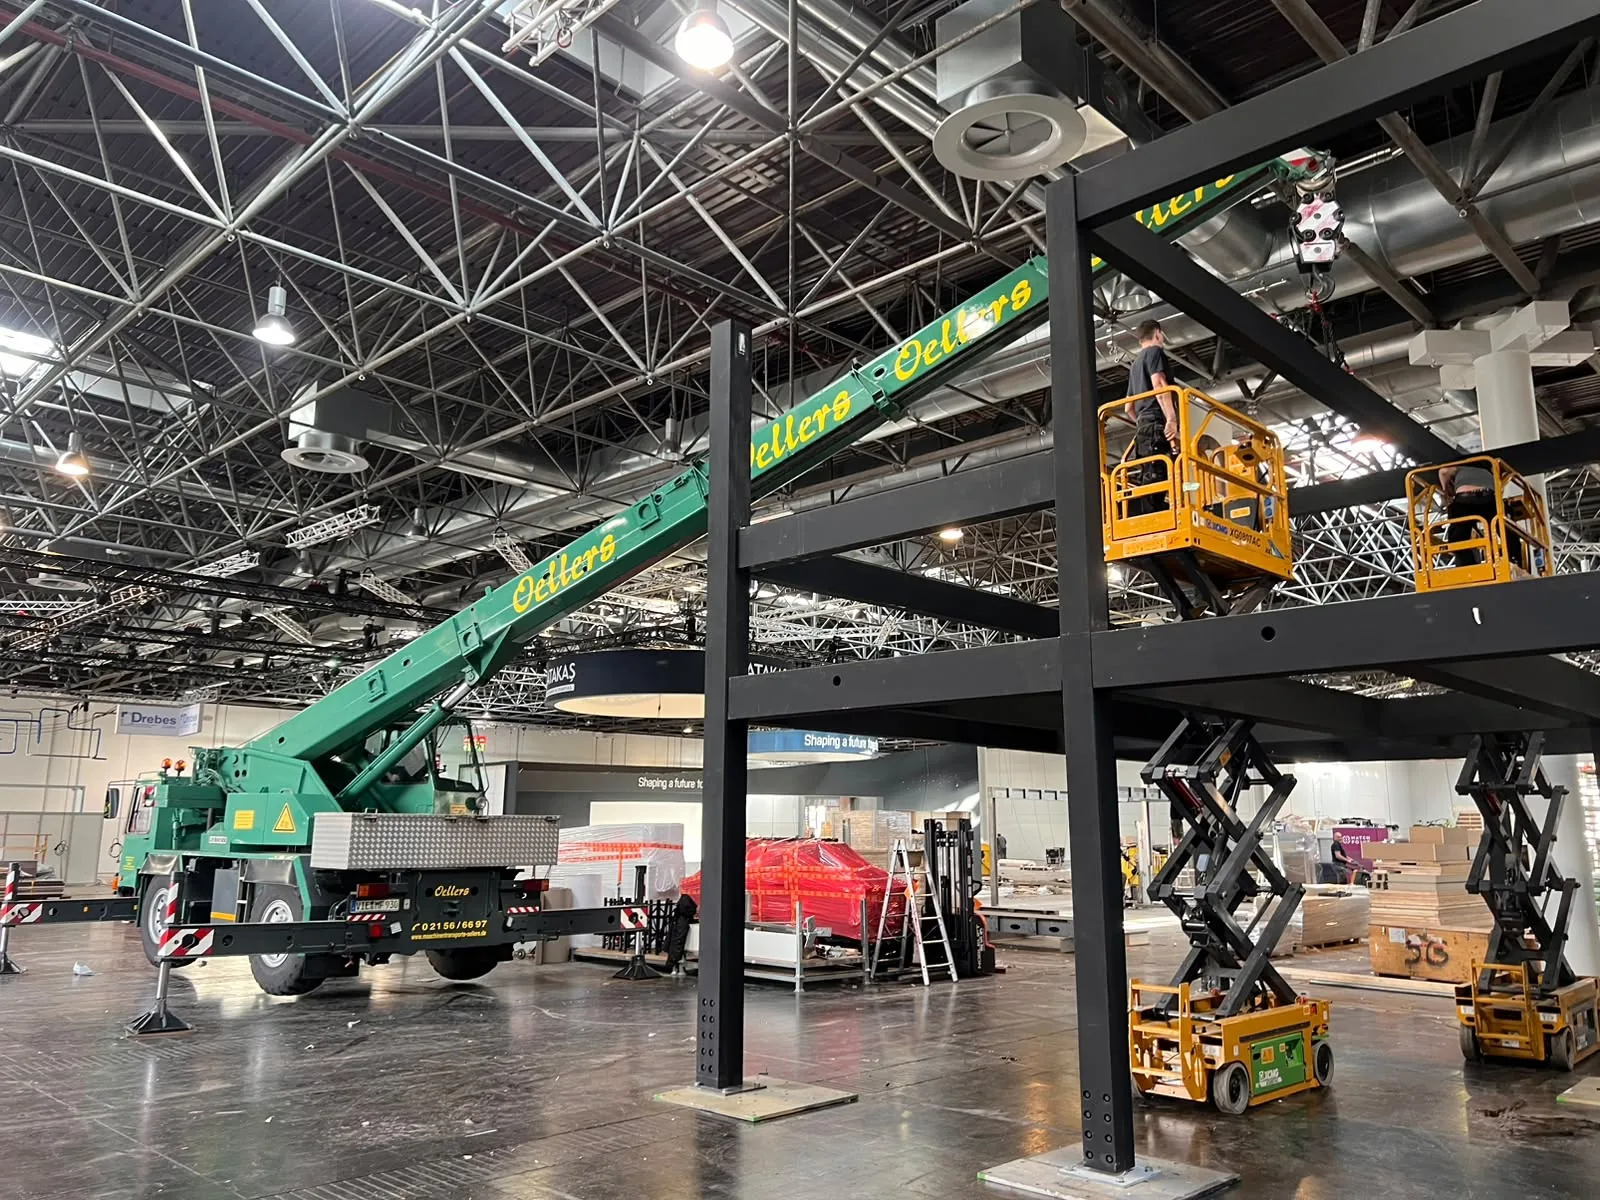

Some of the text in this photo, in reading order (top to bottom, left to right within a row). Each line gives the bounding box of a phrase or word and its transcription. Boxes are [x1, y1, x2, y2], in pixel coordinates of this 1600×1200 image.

[751, 390, 851, 469] ellers
[512, 533, 616, 613] Oellers
[131, 711, 177, 725] Drebes
[804, 733, 841, 750] Shaping
[842, 737, 848, 747] a
[638, 776, 668, 790] Shaping
[668, 779, 674, 788] a
[674, 777, 696, 789] future
[433, 885, 470, 897] Oellers
